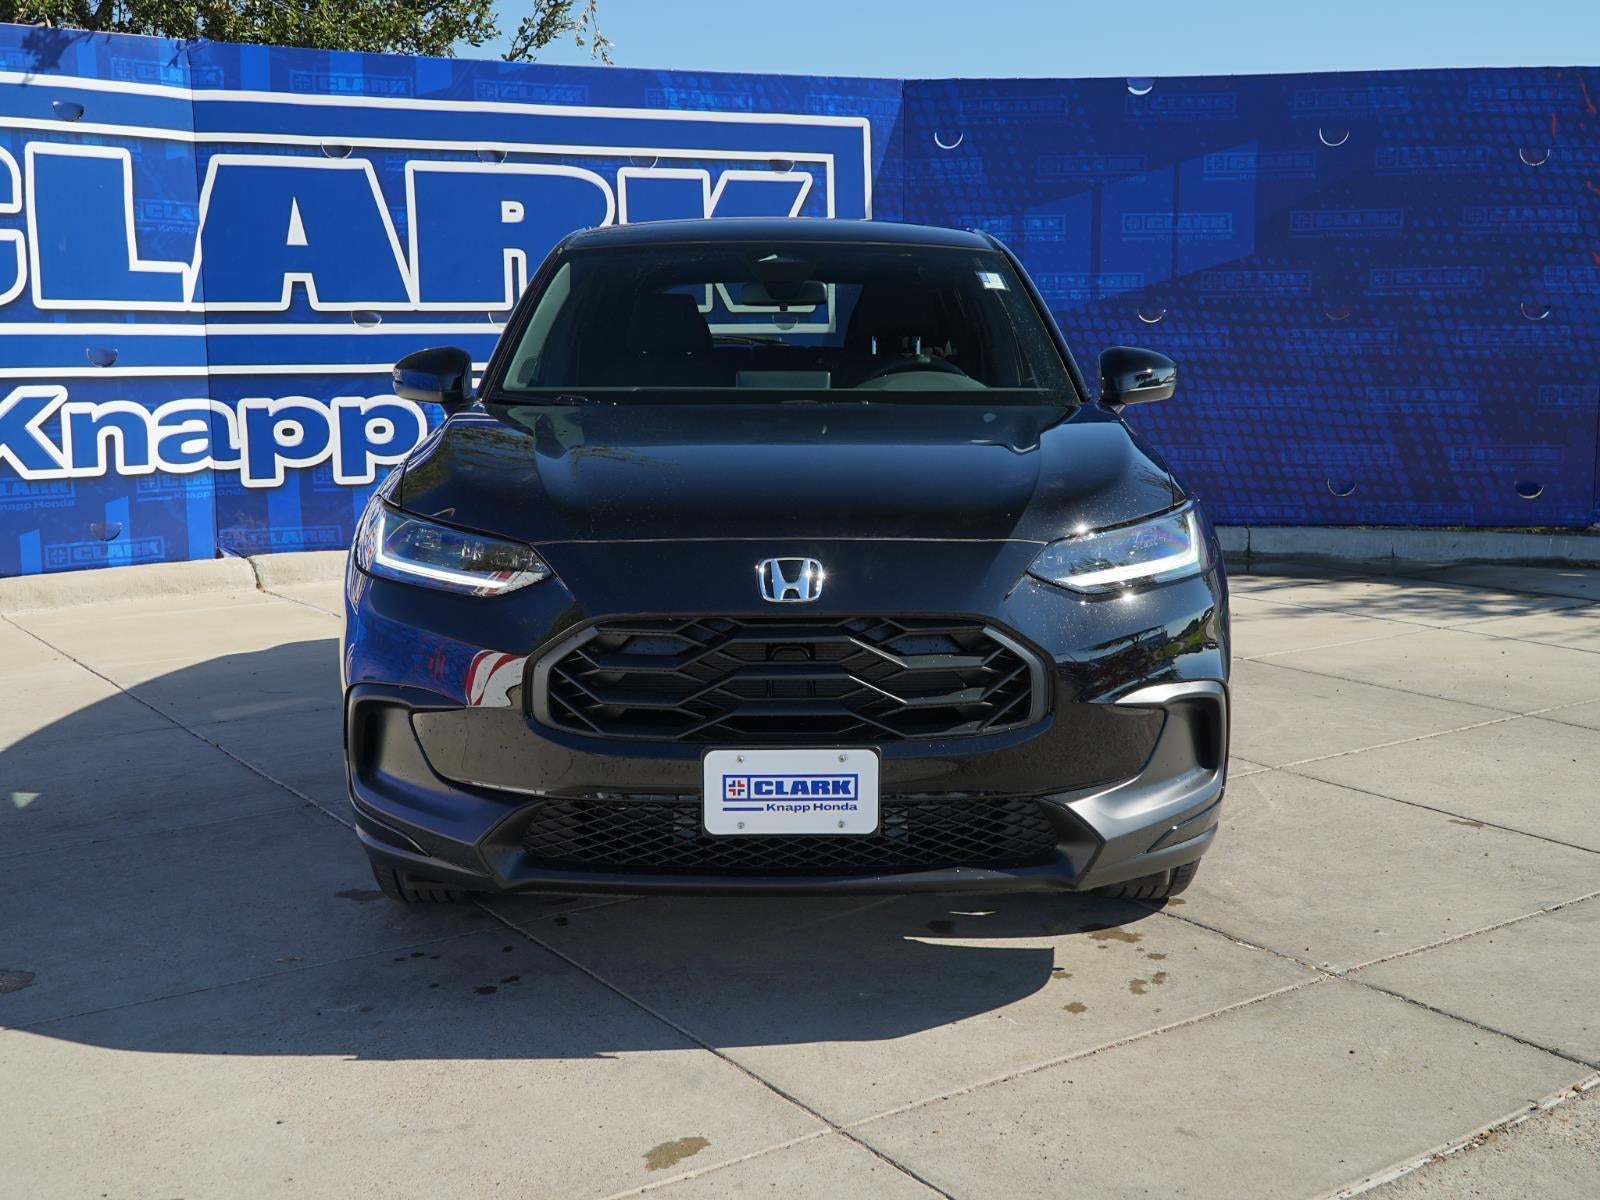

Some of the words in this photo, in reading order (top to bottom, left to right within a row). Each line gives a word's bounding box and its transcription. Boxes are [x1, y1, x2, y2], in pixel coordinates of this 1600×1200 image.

[0, 141, 813, 313] LAR
[0, 502, 32, 512] napp
[753, 780, 852, 796] CLARK
[766, 803, 811, 813] Knapp
[813, 802, 858, 812] Honda
